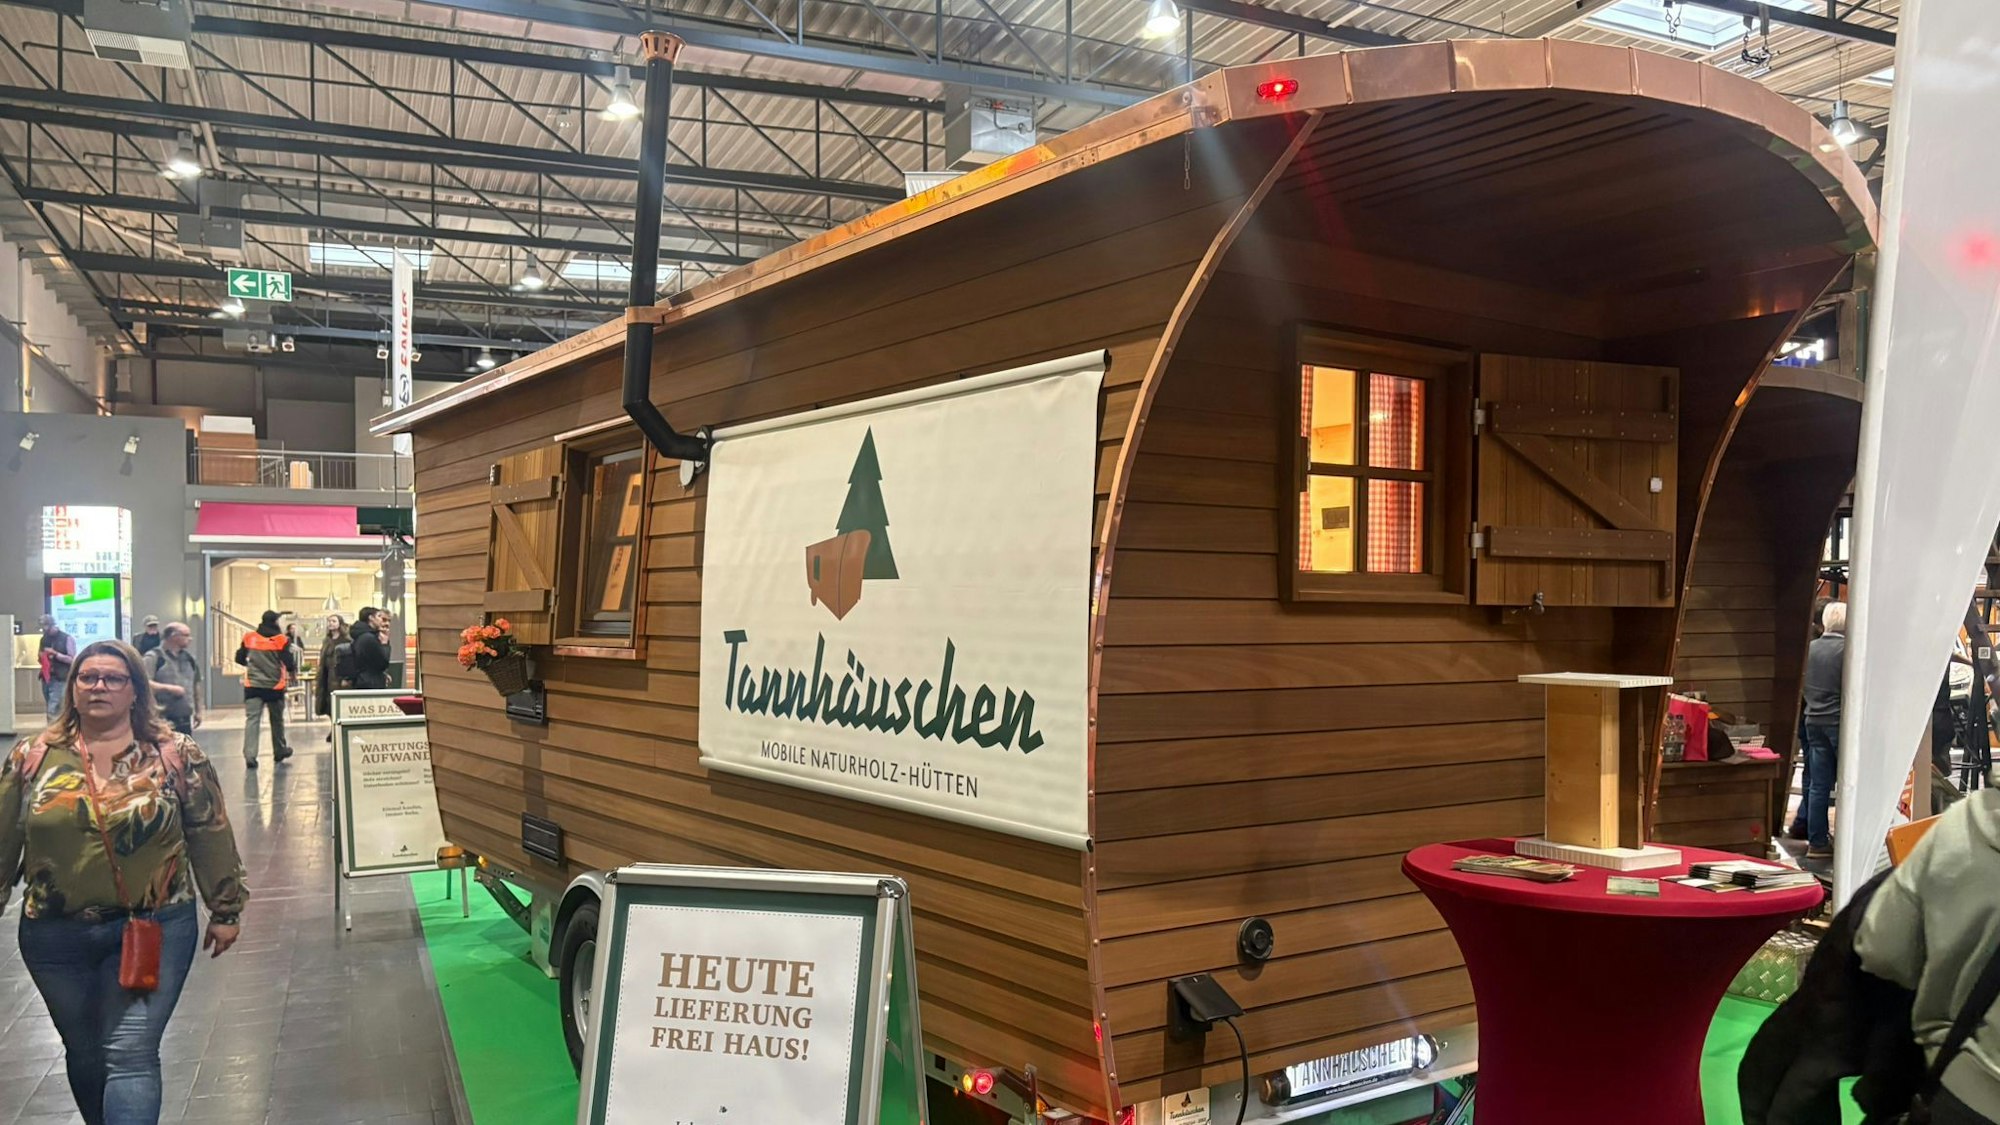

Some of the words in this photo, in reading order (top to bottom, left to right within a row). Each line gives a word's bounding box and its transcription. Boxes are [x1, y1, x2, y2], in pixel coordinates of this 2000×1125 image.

[348, 705, 375, 715] WAS
[723, 629, 1044, 754] Tannhäuschen
[761, 740, 806, 766] MOBILE
[811, 749, 978, 798] NATURHOLZ-HÜTTEN
[657, 953, 815, 998] HEUTE
[654, 996, 813, 1029] LIEFERUNG
[650, 1026, 715, 1053] FREI
[722, 1032, 810, 1061] HAUS!
[1292, 1038, 1412, 1089] TANNHÄUSCHEN
